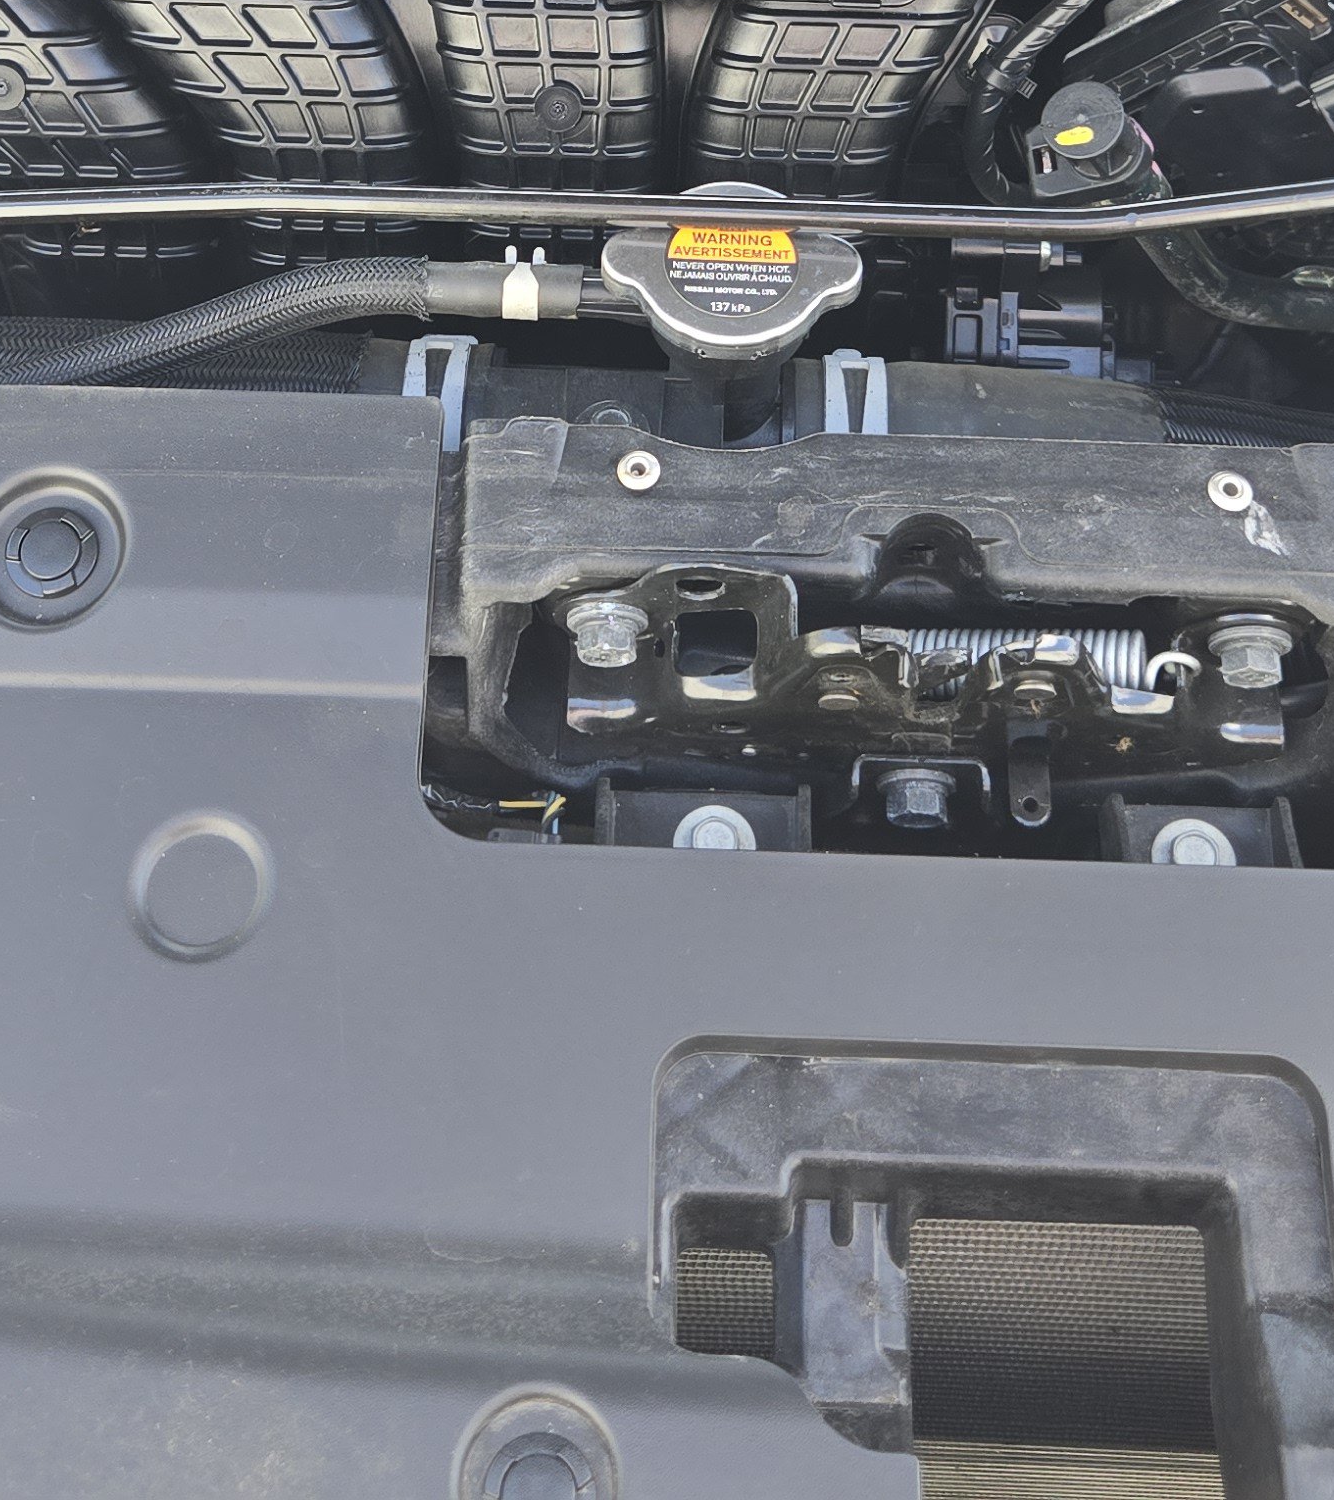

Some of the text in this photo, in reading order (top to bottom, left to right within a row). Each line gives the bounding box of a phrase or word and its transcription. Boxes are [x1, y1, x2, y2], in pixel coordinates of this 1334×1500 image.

[692, 232, 773, 246] WARNING
[673, 246, 791, 260] AVERTISSEMENT
[672, 261, 791, 273] NEVER OPEN WHEN HOT.
[669, 270, 682, 279] NE
[682, 271, 715, 280] JAMAIS
[716, 272, 749, 281] OUVRIR
[757, 274, 793, 283] CHAUD.
[684, 285, 714, 293] NISSAN
[745, 288, 760, 296] CO.,
[710, 302, 751, 313] 137 kPa
